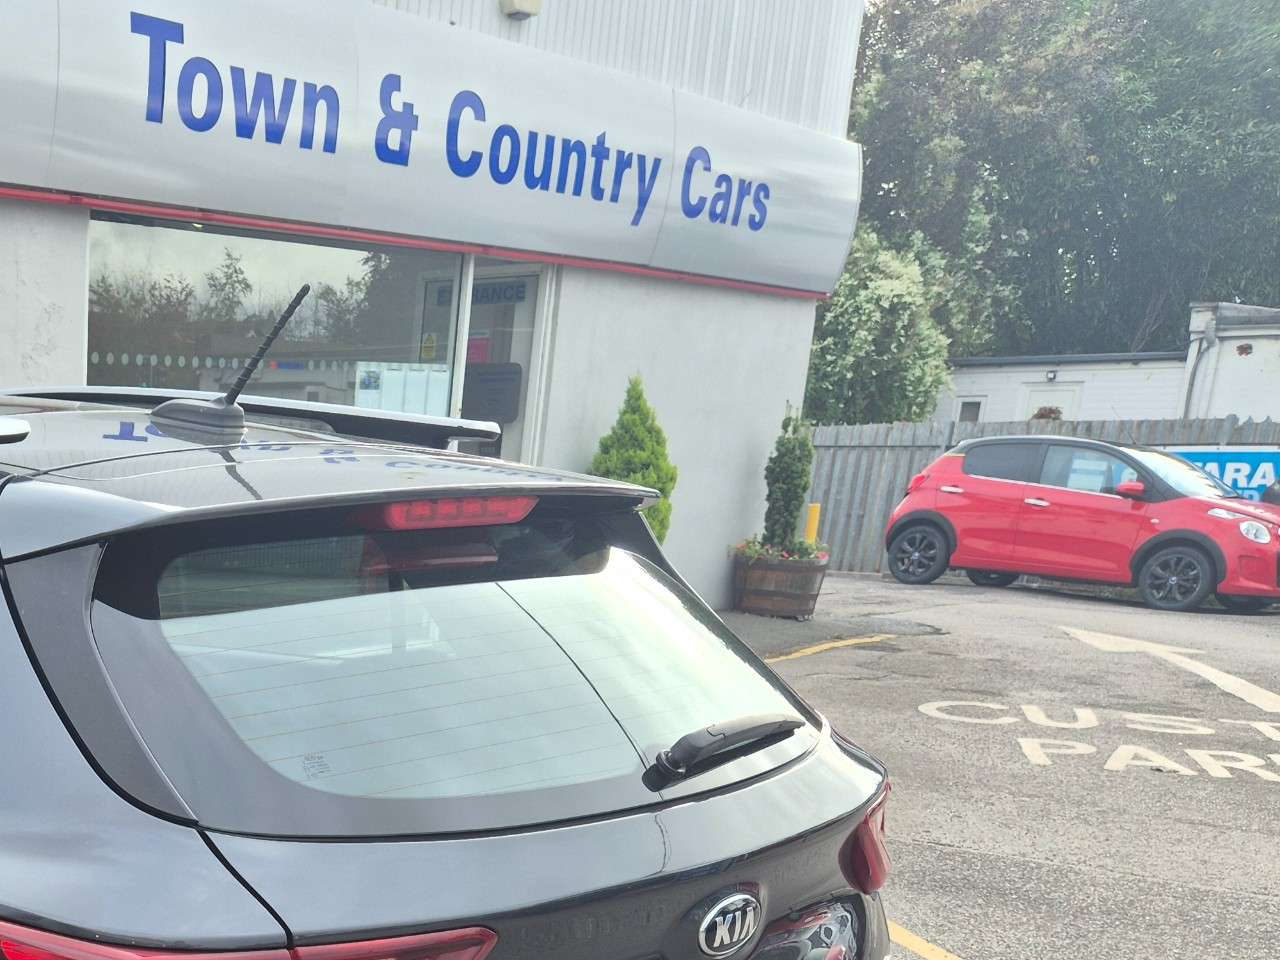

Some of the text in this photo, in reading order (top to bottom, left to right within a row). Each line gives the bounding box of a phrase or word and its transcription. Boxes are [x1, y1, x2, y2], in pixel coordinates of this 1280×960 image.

[130, 11, 770, 232] Town & Country Cars
[1017, 737, 1280, 783] PAR
